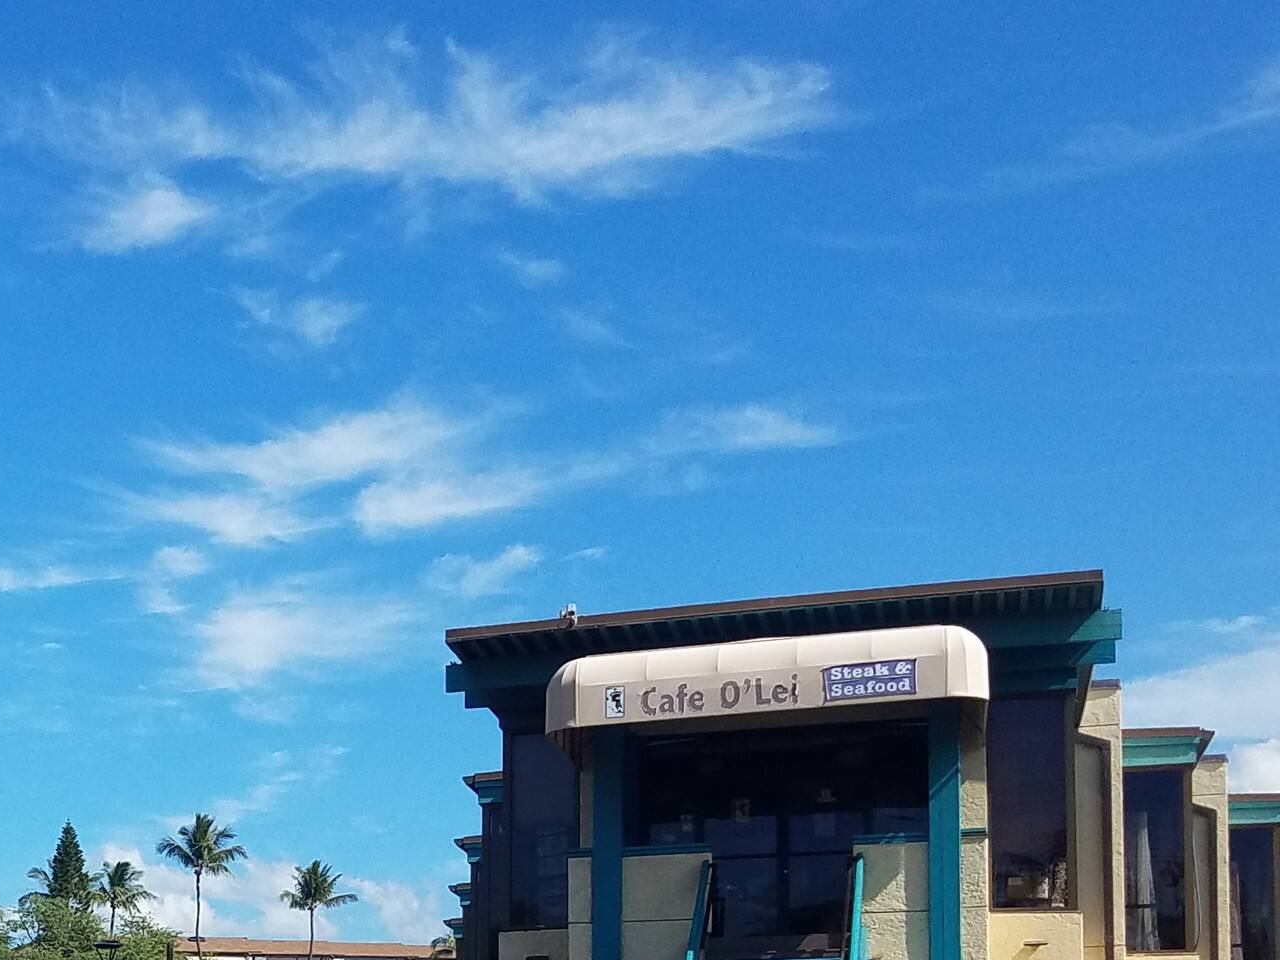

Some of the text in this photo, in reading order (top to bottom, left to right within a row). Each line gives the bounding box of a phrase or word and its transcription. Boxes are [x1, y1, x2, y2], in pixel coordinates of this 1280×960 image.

[830, 661, 911, 681] Steak &
[641, 673, 800, 717] Cafe O'Lei
[830, 678, 911, 698] Seafood
